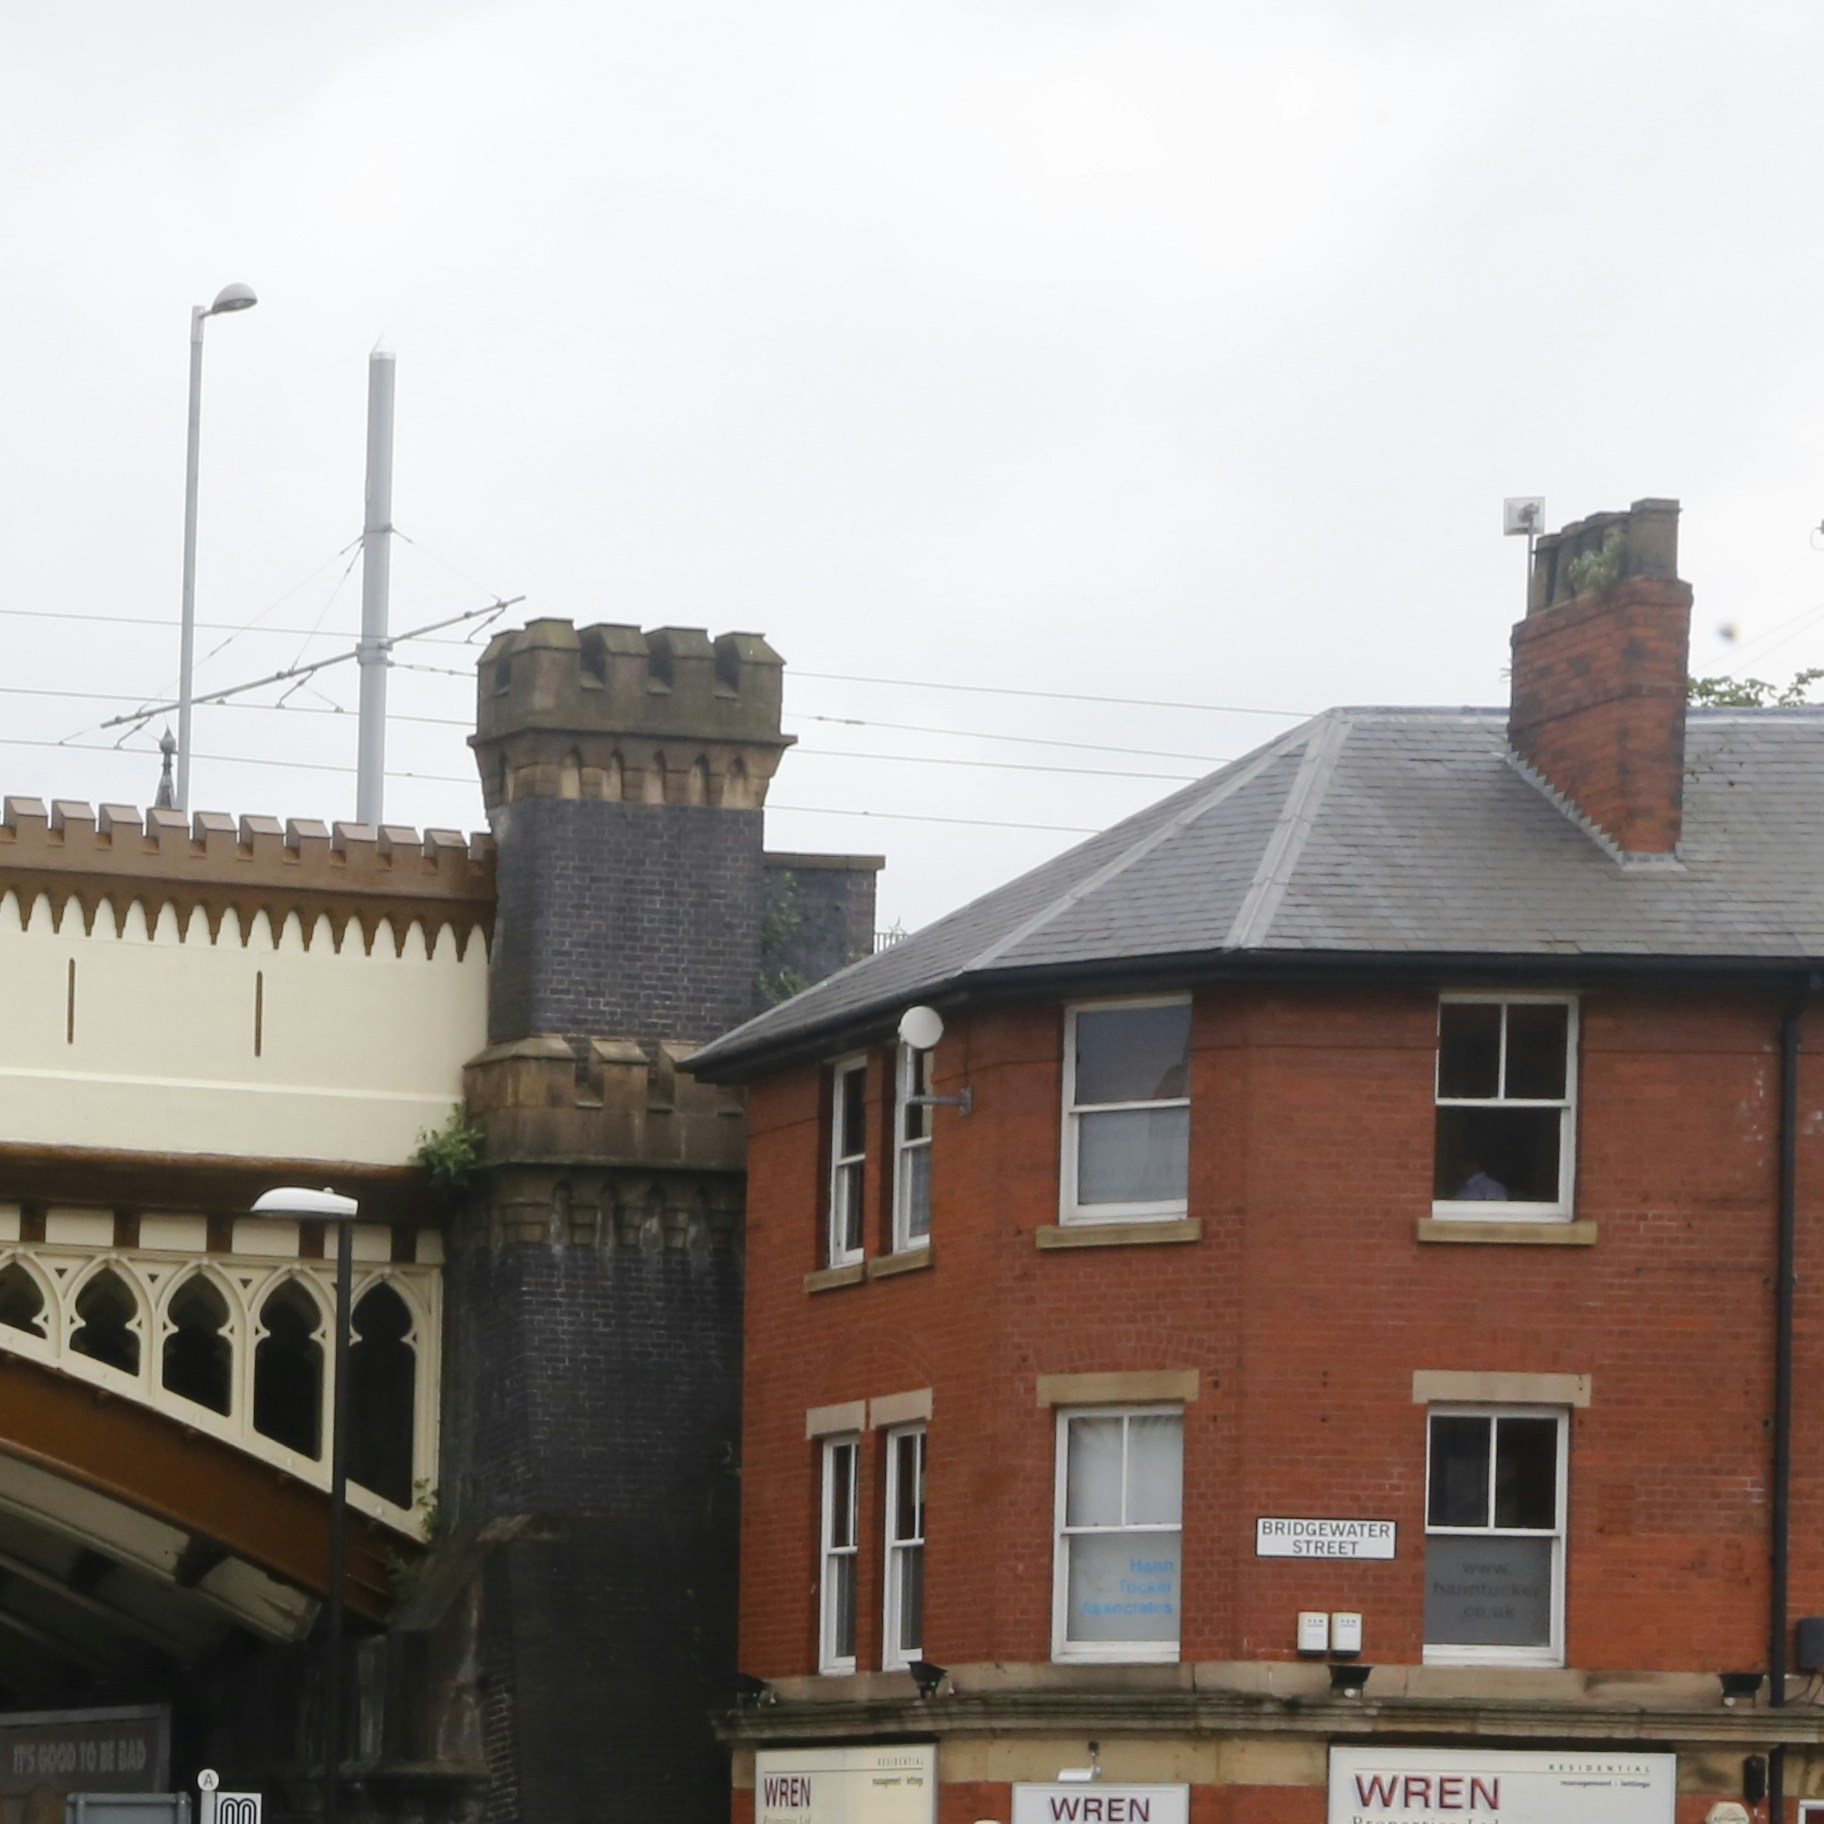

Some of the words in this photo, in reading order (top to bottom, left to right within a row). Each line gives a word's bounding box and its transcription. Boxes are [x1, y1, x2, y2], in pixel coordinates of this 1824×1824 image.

[1262, 1520, 1391, 1538] BRIDGEWATER
[1292, 1539, 1358, 1556] STREET
[13, 1743, 36, 1774] IT'S
[38, 1742, 76, 1774] GOOD
[79, 1741, 97, 1770] TO
[98, 1740, 116, 1770] BE
[118, 1738, 146, 1772] BAD
[1548, 1763, 1651, 1773] RESIDENTIAL
[203, 1773, 214, 1787] A
[764, 1775, 811, 1808] WREN
[1355, 1773, 1502, 1811] WREN
[1050, 1796, 1150, 1822] WREN
